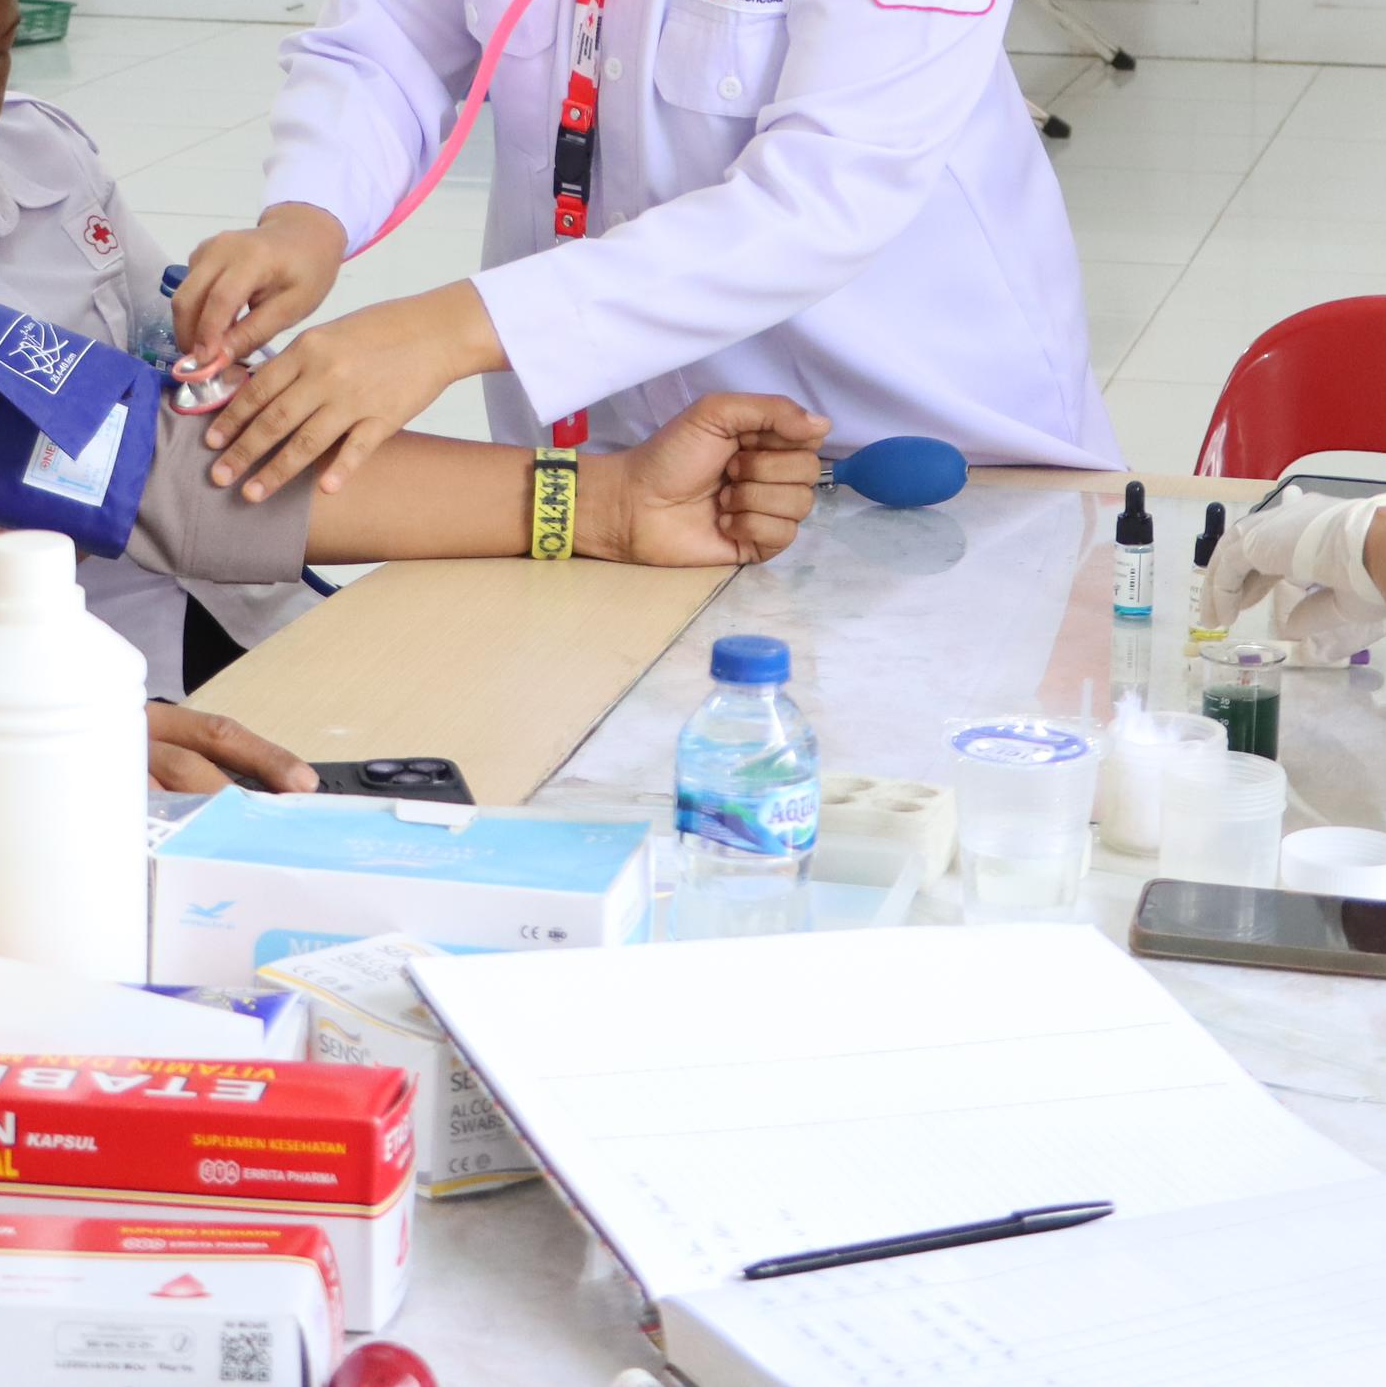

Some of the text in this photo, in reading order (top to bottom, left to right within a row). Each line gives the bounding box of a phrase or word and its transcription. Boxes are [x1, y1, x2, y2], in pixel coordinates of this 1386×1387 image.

[451, 1100, 492, 1118] ALCO
[26, 1132, 98, 1151] KAPSUL
[192, 1133, 347, 1154] SUPLEMEN KESEHATAN
